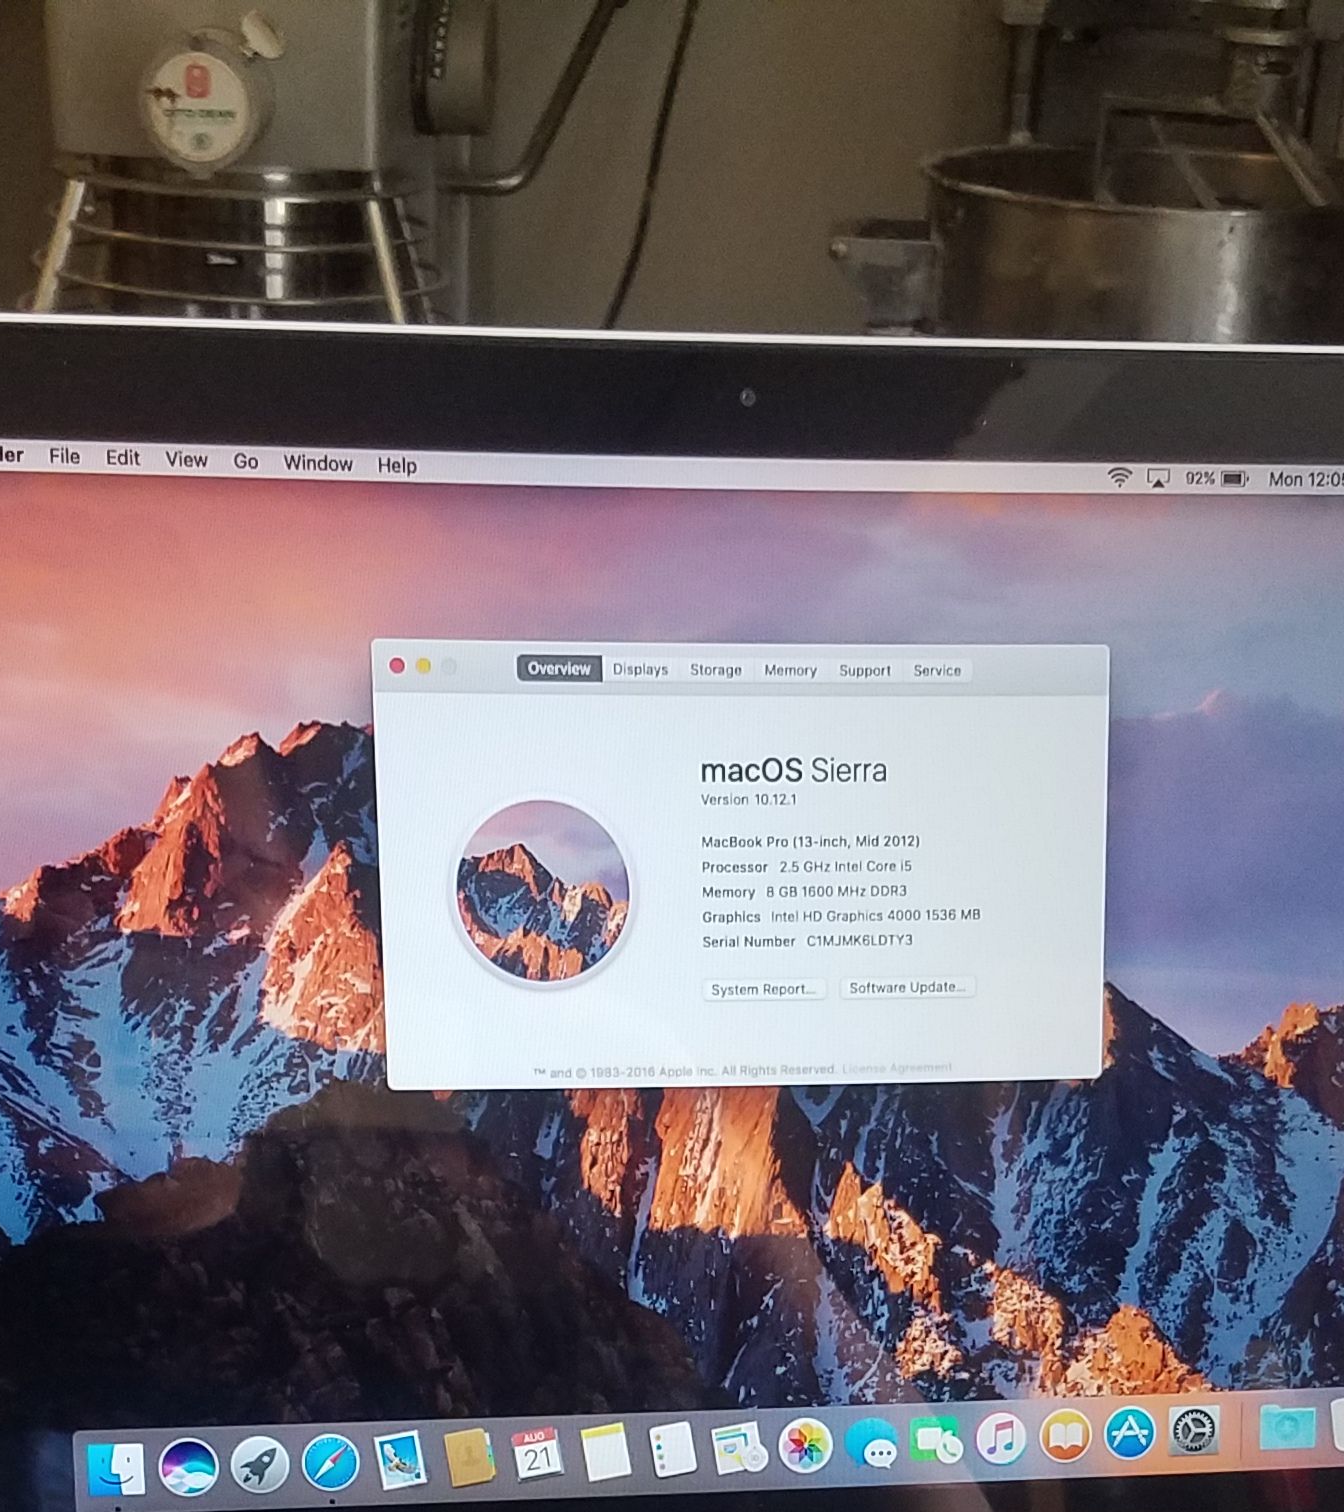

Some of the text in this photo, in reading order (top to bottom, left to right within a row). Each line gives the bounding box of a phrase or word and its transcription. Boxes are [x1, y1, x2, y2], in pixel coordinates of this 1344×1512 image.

[49, 447, 80, 464] File
[107, 449, 140, 466] Edit
[166, 451, 208, 468] View
[234, 453, 258, 470] Go
[284, 454, 353, 472] Window
[378, 457, 417, 476] Help
[1270, 472, 1302, 486] Mon
[528, 661, 961, 679] Overview Displays Storage Memory Support Service
[701, 758, 887, 783] macOS Sierra
[701, 794, 796, 805] Version 10.12.1
[702, 835, 920, 849] MacBook Pro (13-inch, Mid 2012)
[702, 860, 912, 873] Processor 2.5 GHz Intel Core i5
[703, 885, 906, 900] Memory 8 GB 1600 MHz DDR3
[703, 909, 980, 925] Graphics Intel HD Graphics 4000 1536 MB
[703, 936, 739, 948] Serial
[745, 936, 795, 948] Number
[712, 984, 759, 998] System
[850, 982, 905, 995] Software
[550, 1068, 572, 1079] and
[659, 1067, 693, 1080] Apple
[740, 1064, 776, 1079] Rights
[524, 1446, 551, 1471] 21
